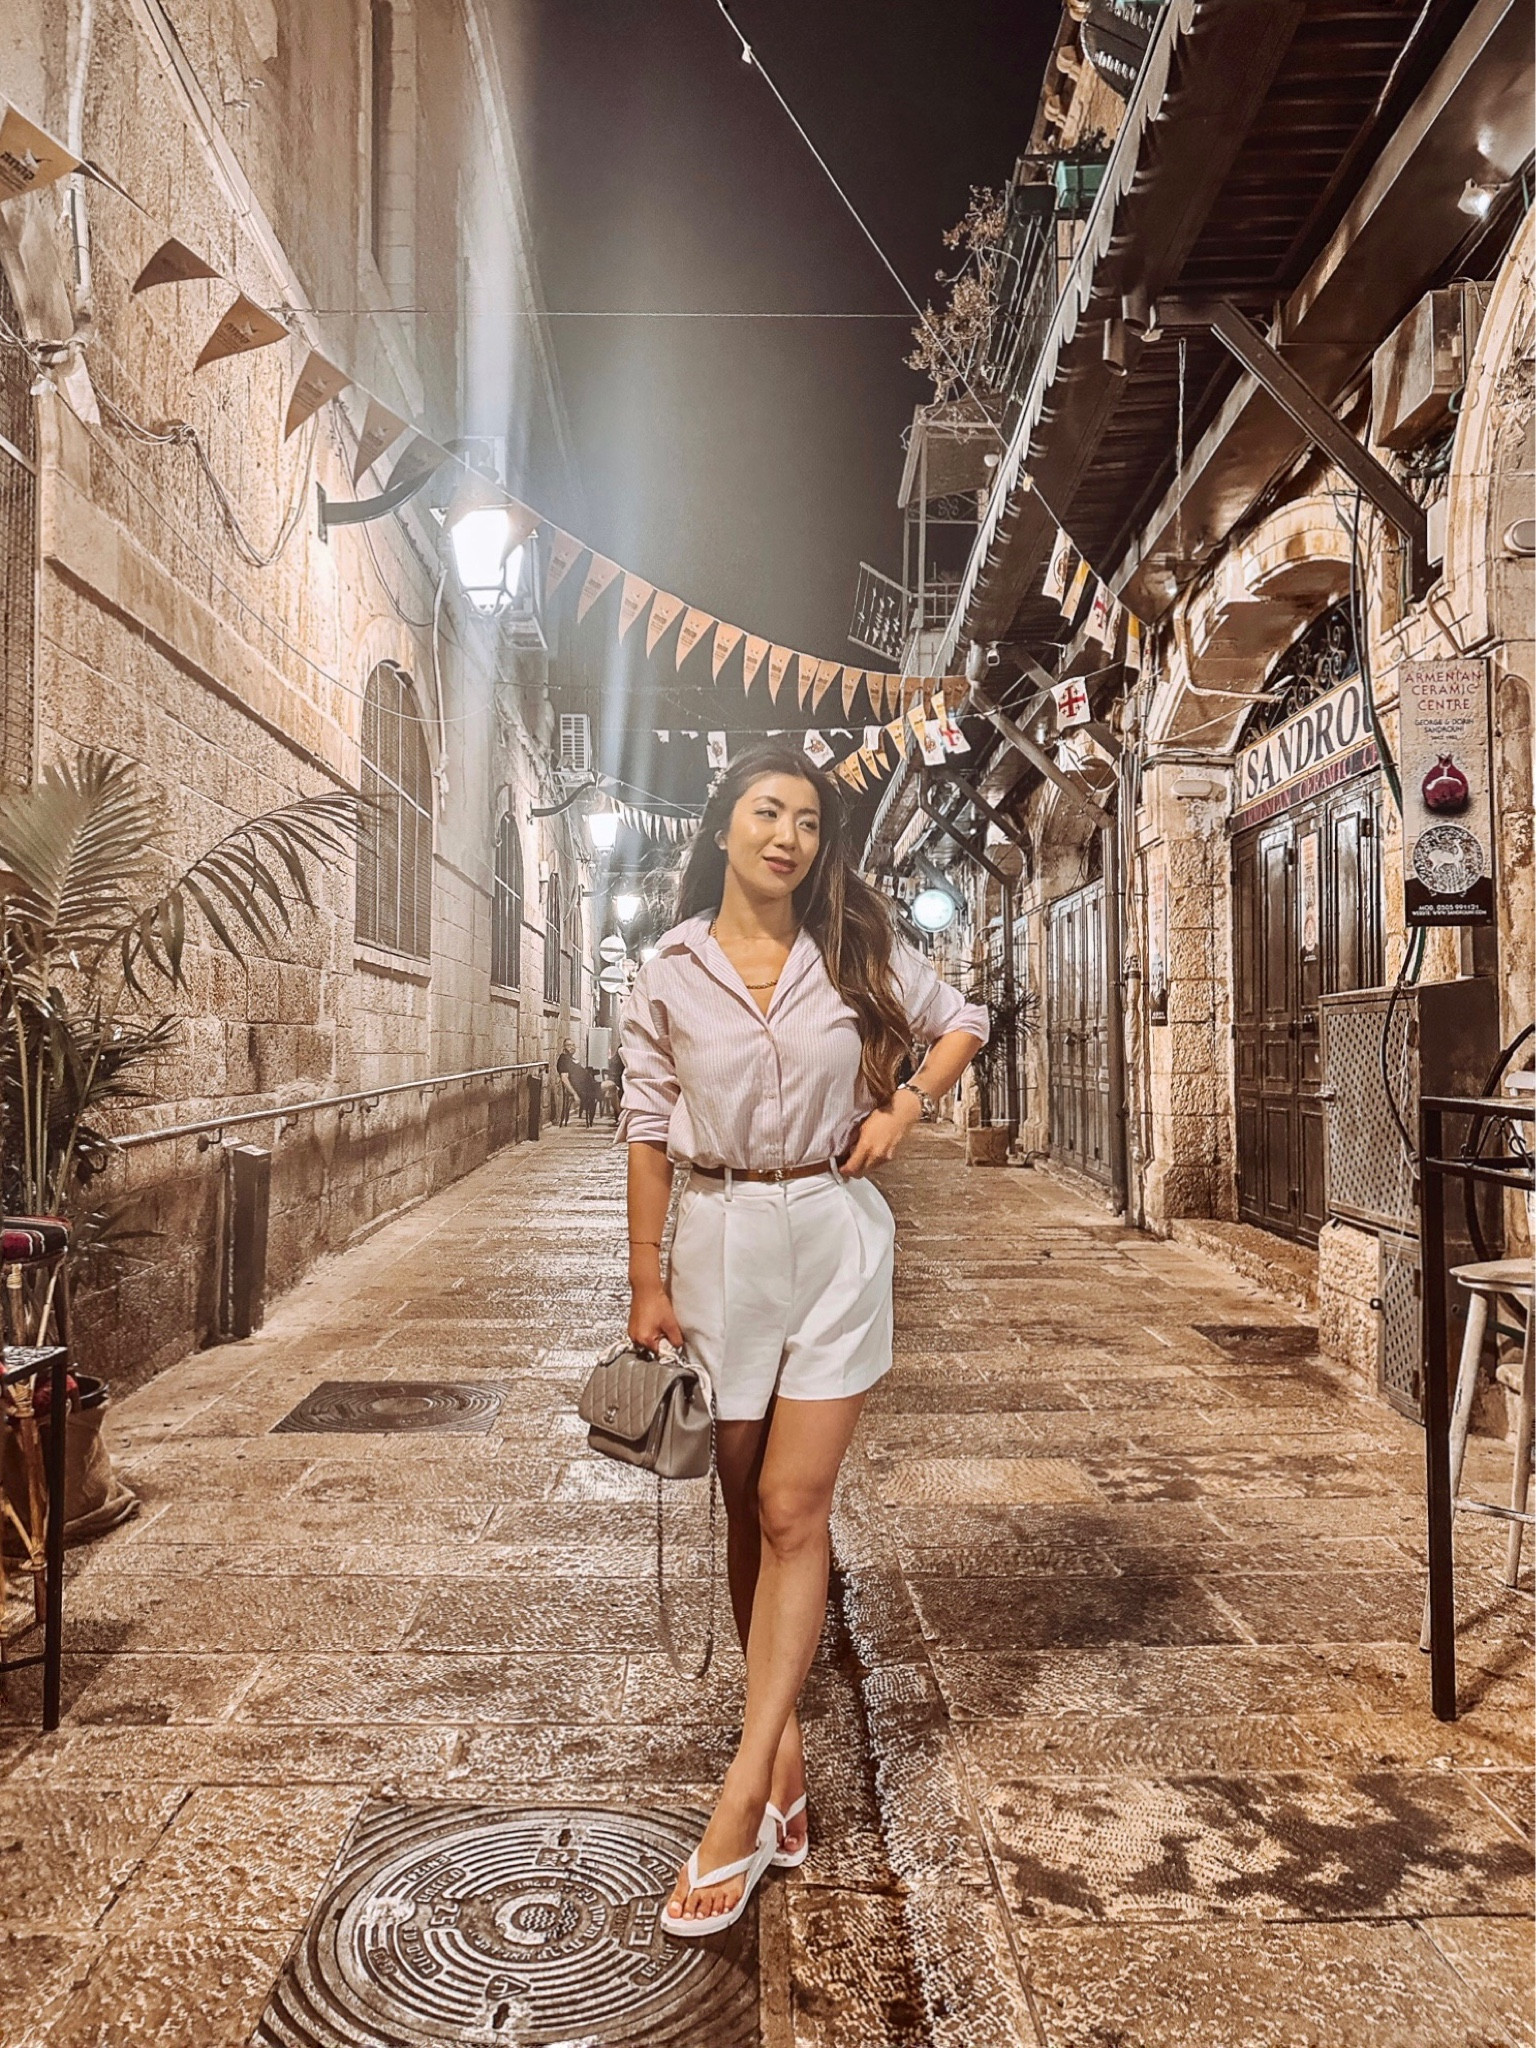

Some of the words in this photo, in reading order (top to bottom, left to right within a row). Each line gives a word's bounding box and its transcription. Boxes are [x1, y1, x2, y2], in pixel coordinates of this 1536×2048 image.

[1405, 671, 1483, 683] ARMENIAN
[1412, 684, 1476, 695] CERAMIC
[1417, 699, 1470, 712] CENTRE
[1423, 726, 1465, 734] SANDROUNI
[405, 1854, 451, 1881] EN124
[430, 1902, 459, 1926] 25
[640, 1943, 680, 1978] הגיחו
